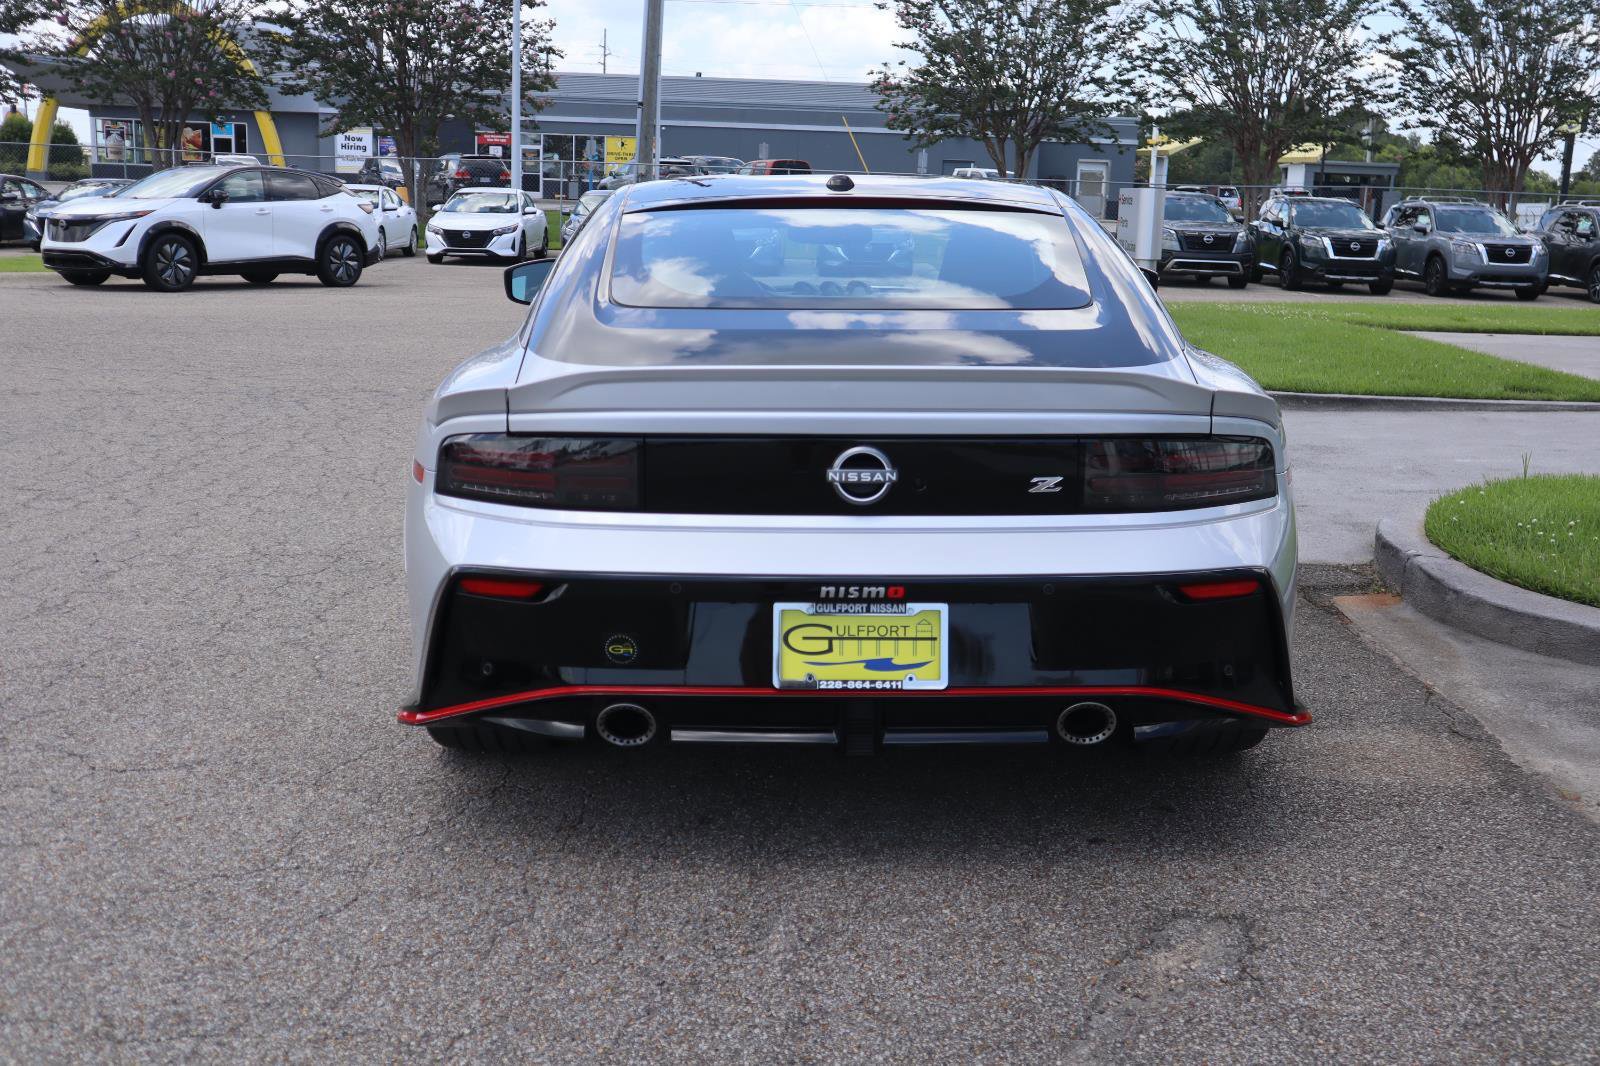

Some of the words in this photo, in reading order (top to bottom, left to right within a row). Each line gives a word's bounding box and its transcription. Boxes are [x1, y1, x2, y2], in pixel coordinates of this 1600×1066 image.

[344, 134, 363, 142] Now
[340, 143, 367, 152] Hiring
[828, 471, 897, 482] NISSAN
[1028, 476, 1064, 493] Z
[820, 586, 905, 598] nismo
[816, 602, 868, 613] GULFPORT
[870, 603, 906, 613] NISSAN
[819, 681, 902, 689] 228-864-6411
